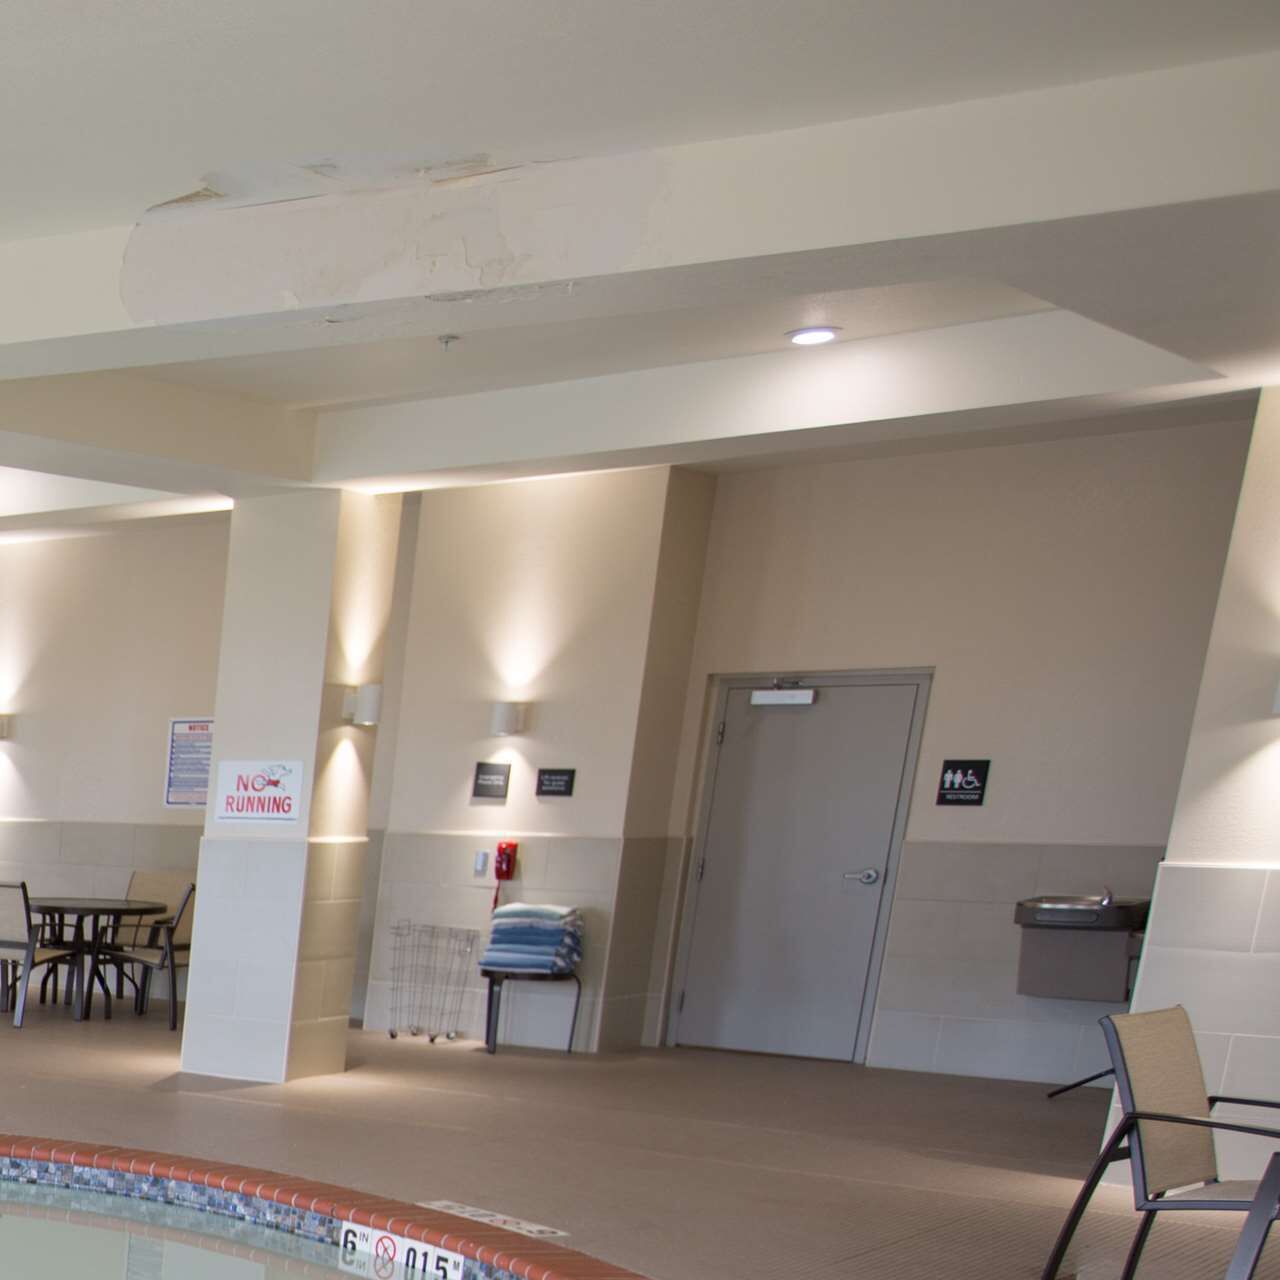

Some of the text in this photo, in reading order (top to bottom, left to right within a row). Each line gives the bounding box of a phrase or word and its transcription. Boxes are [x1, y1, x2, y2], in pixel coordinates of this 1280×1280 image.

[236, 774, 267, 792] NO
[225, 795, 292, 814] RUNNING
[343, 1229, 357, 1251] 6
